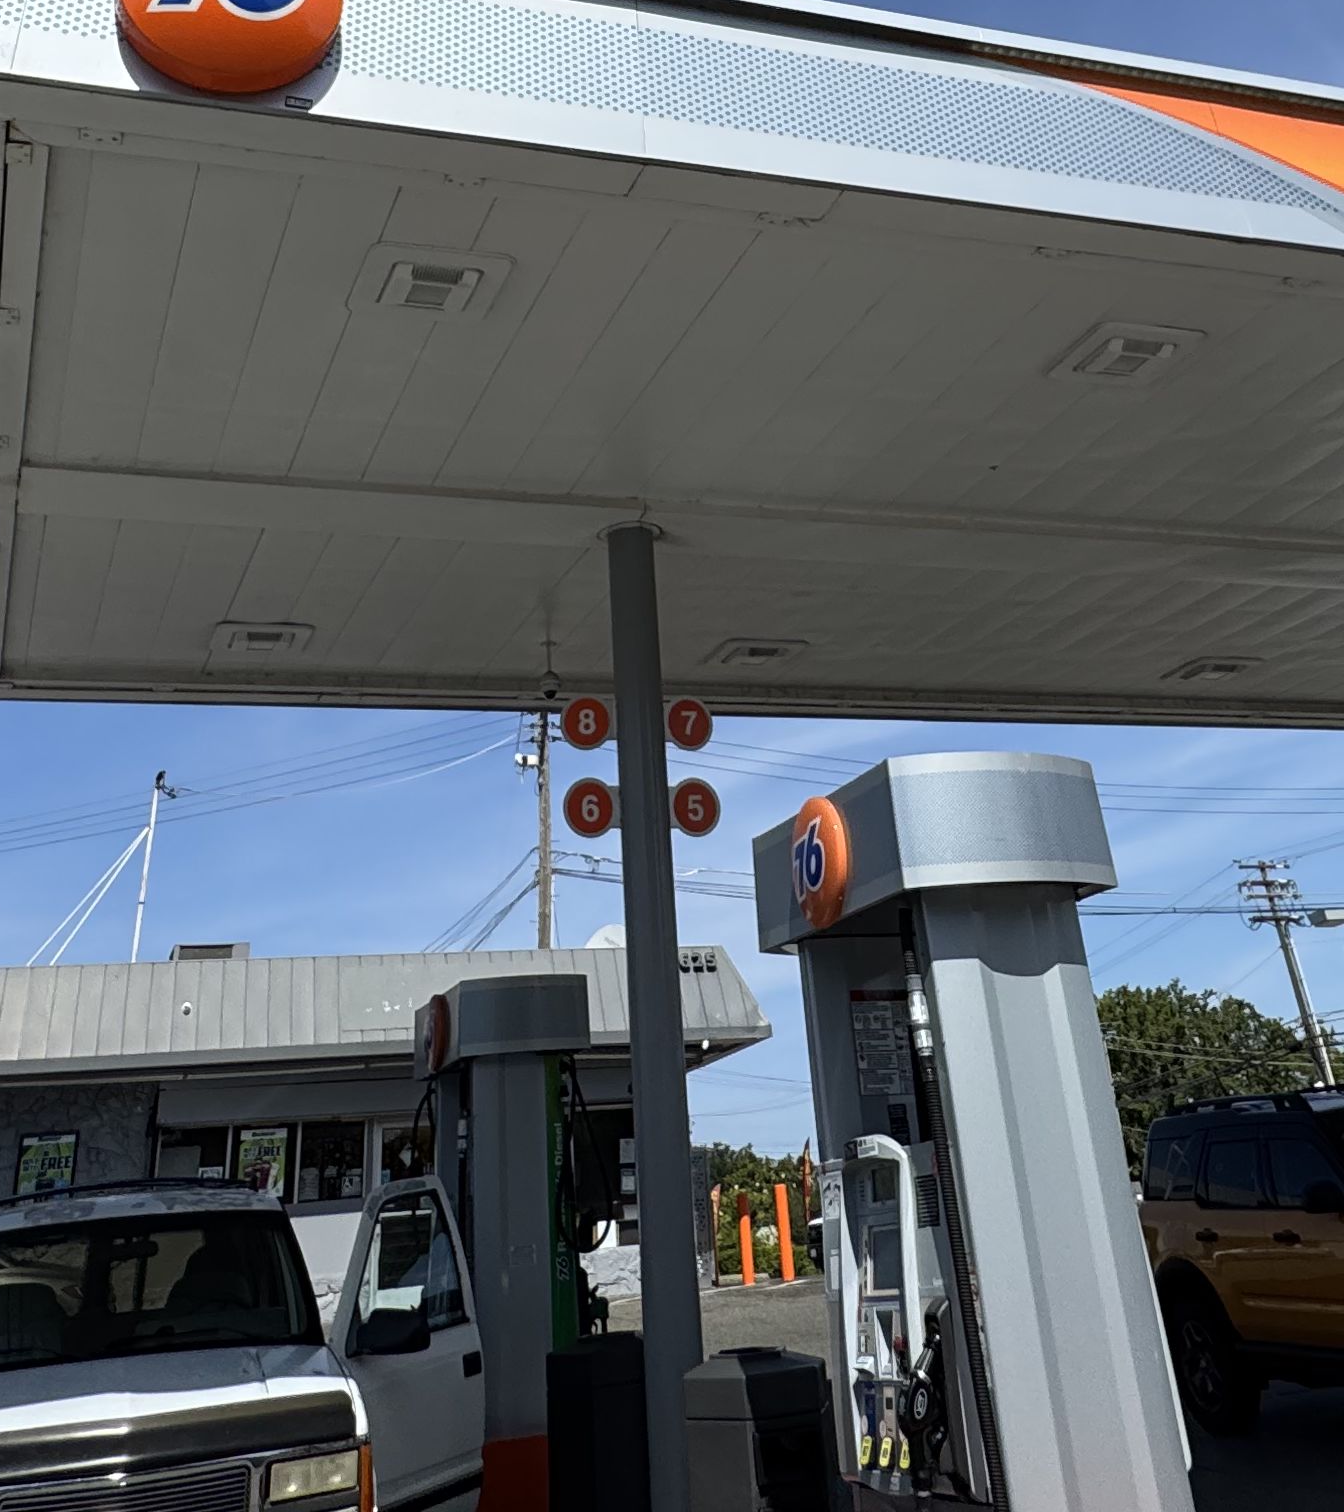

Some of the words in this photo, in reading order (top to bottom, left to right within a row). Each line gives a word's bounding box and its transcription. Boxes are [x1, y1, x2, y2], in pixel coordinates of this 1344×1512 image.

[578, 708, 597, 735] 8
[680, 710, 698, 736] 7
[581, 794, 600, 823] 6
[687, 794, 704, 822] 5
[792, 815, 826, 904] 76
[554, 1122, 563, 1166] Diesel
[40, 1155, 72, 1171] FREE
